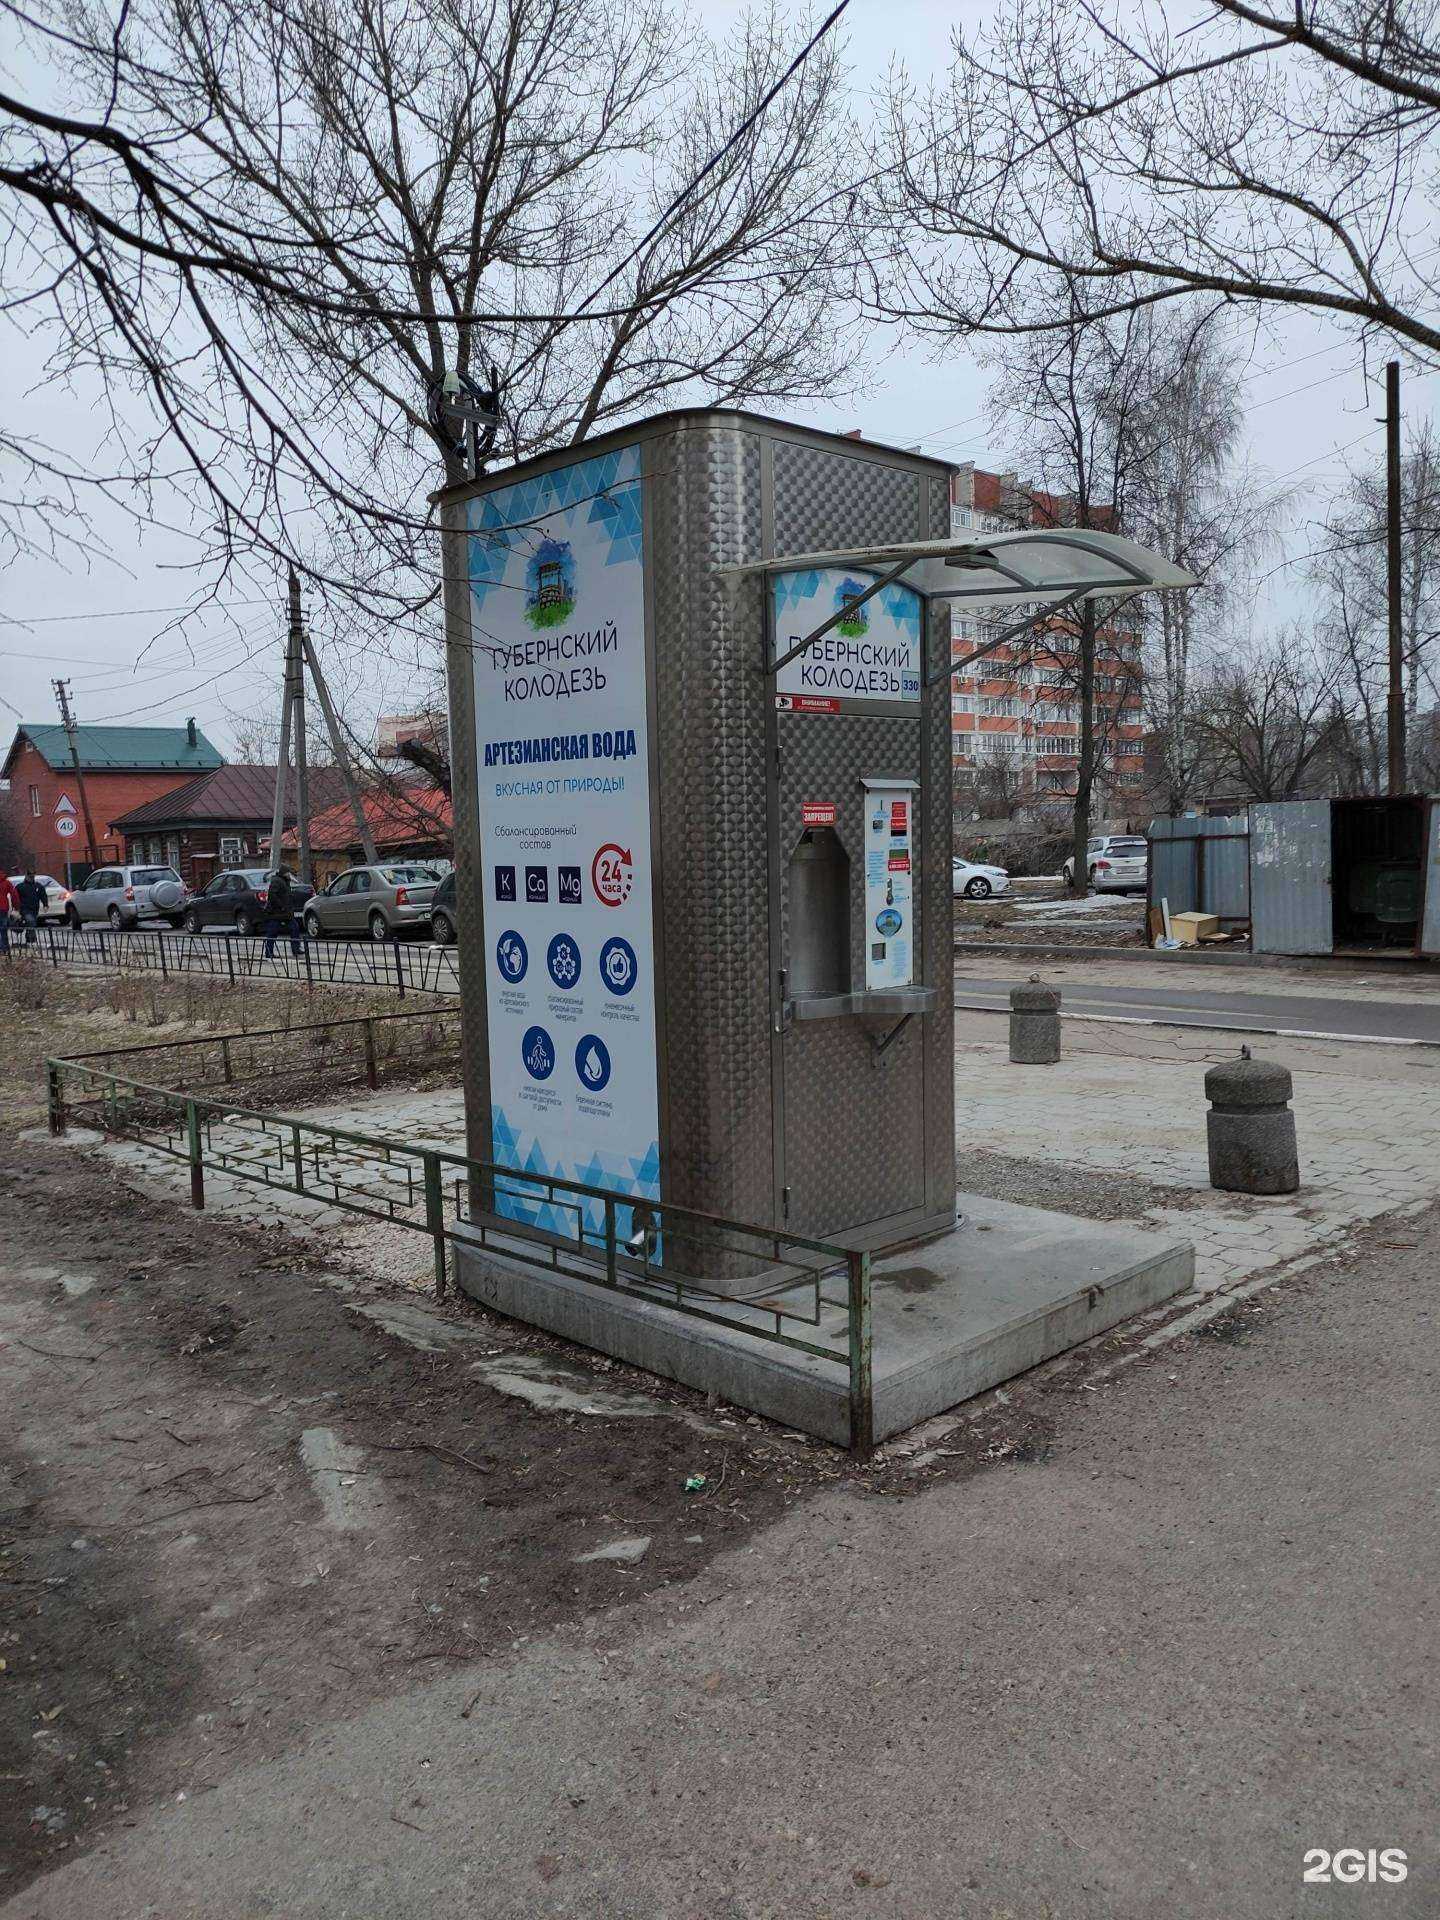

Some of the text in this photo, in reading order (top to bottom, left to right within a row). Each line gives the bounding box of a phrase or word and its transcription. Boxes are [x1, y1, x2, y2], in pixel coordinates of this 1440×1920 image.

[492, 620, 618, 670] ГУБЕРНСКИЙ
[504, 666, 607, 702] КОЛОДЕЗЬ
[801, 665, 901, 694] КОЛОДЕЗЬ
[903, 680, 919, 692] 330
[484, 729, 637, 767] АРТЕЗИАНСКАЯ ВОДА
[495, 776, 625, 797] ВКУСНАЯ ОТ ПРИРОДЫ!
[60, 821, 74, 831] 40
[494, 823, 577, 837] Сбалансированный
[519, 839, 552, 849] состав
[601, 860, 622, 882] 24
[527, 874, 545, 892] Ca
[560, 876, 581, 897] Mg
[602, 884, 622, 894] часа
